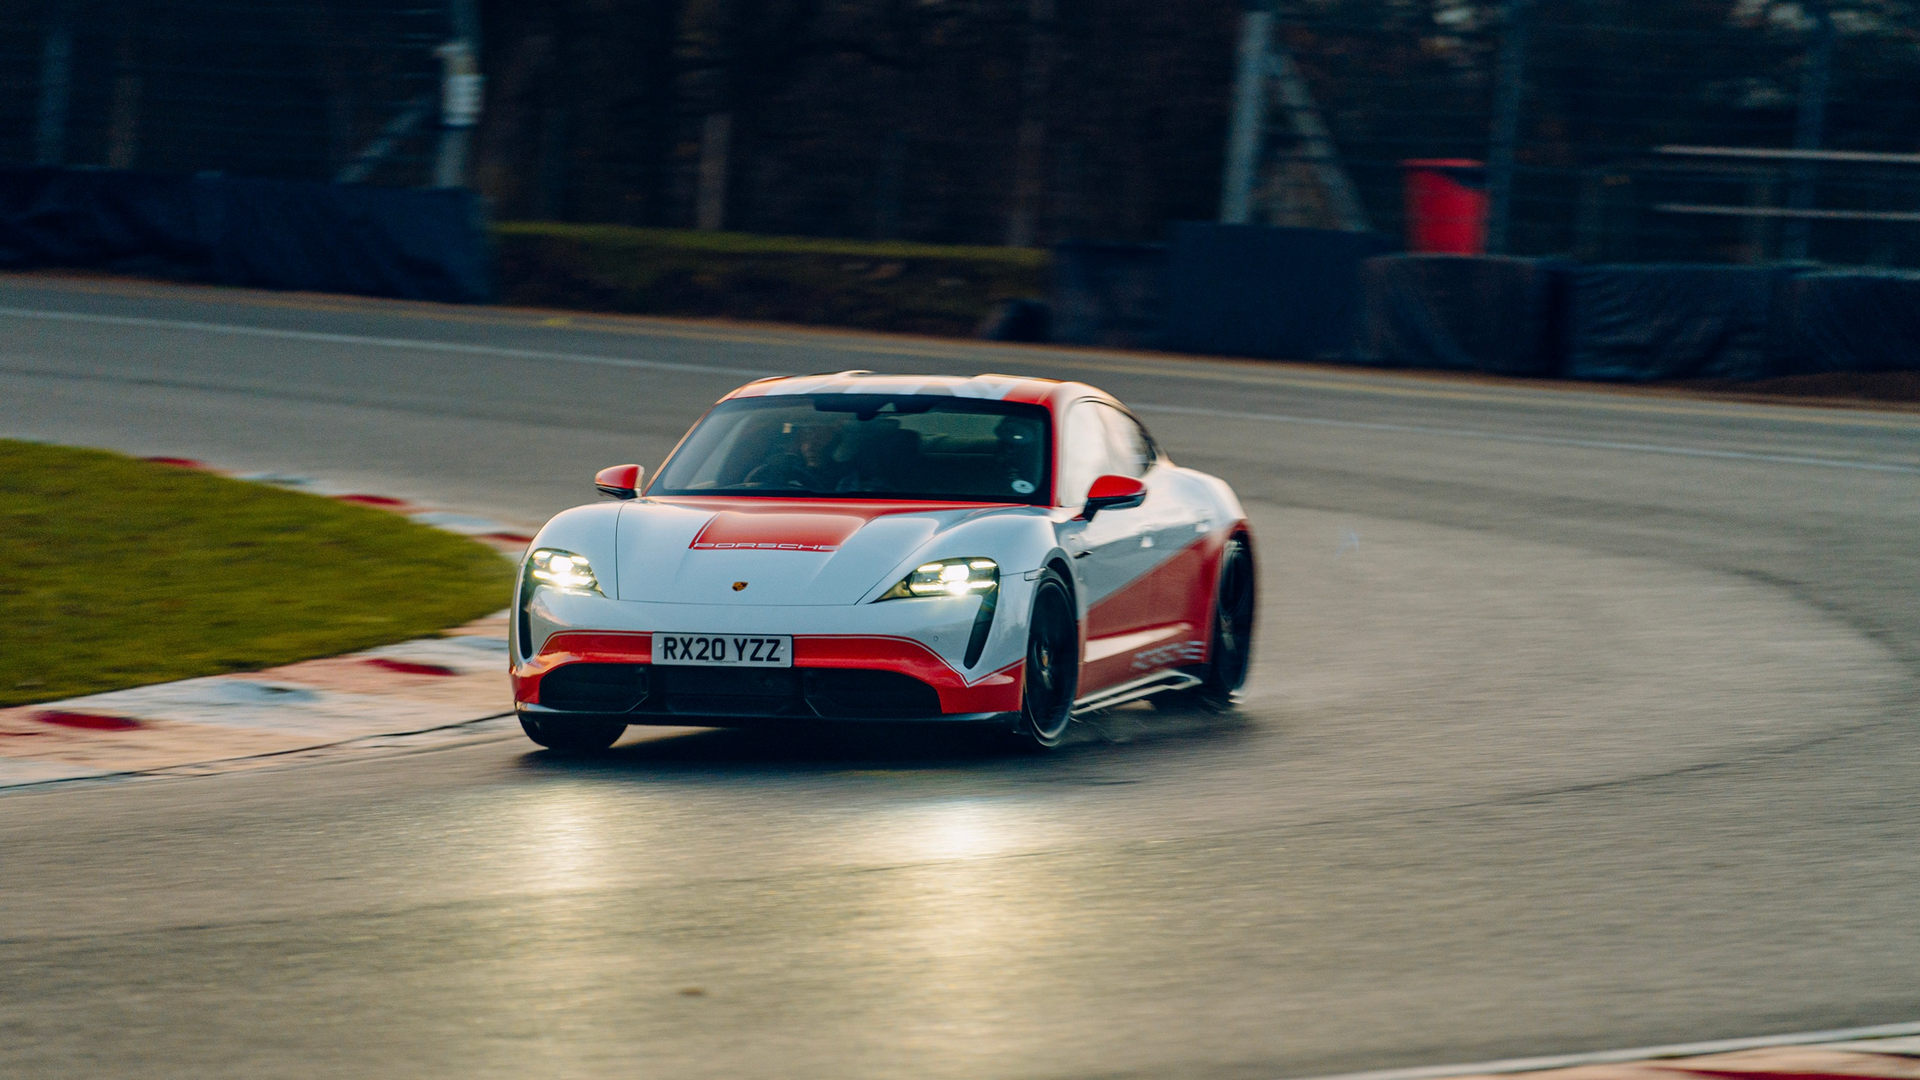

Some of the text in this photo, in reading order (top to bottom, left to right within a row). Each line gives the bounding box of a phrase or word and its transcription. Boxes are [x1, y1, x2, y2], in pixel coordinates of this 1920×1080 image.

[694, 542, 840, 551] PORSCHE
[663, 637, 781, 662] RX20 YZZ
